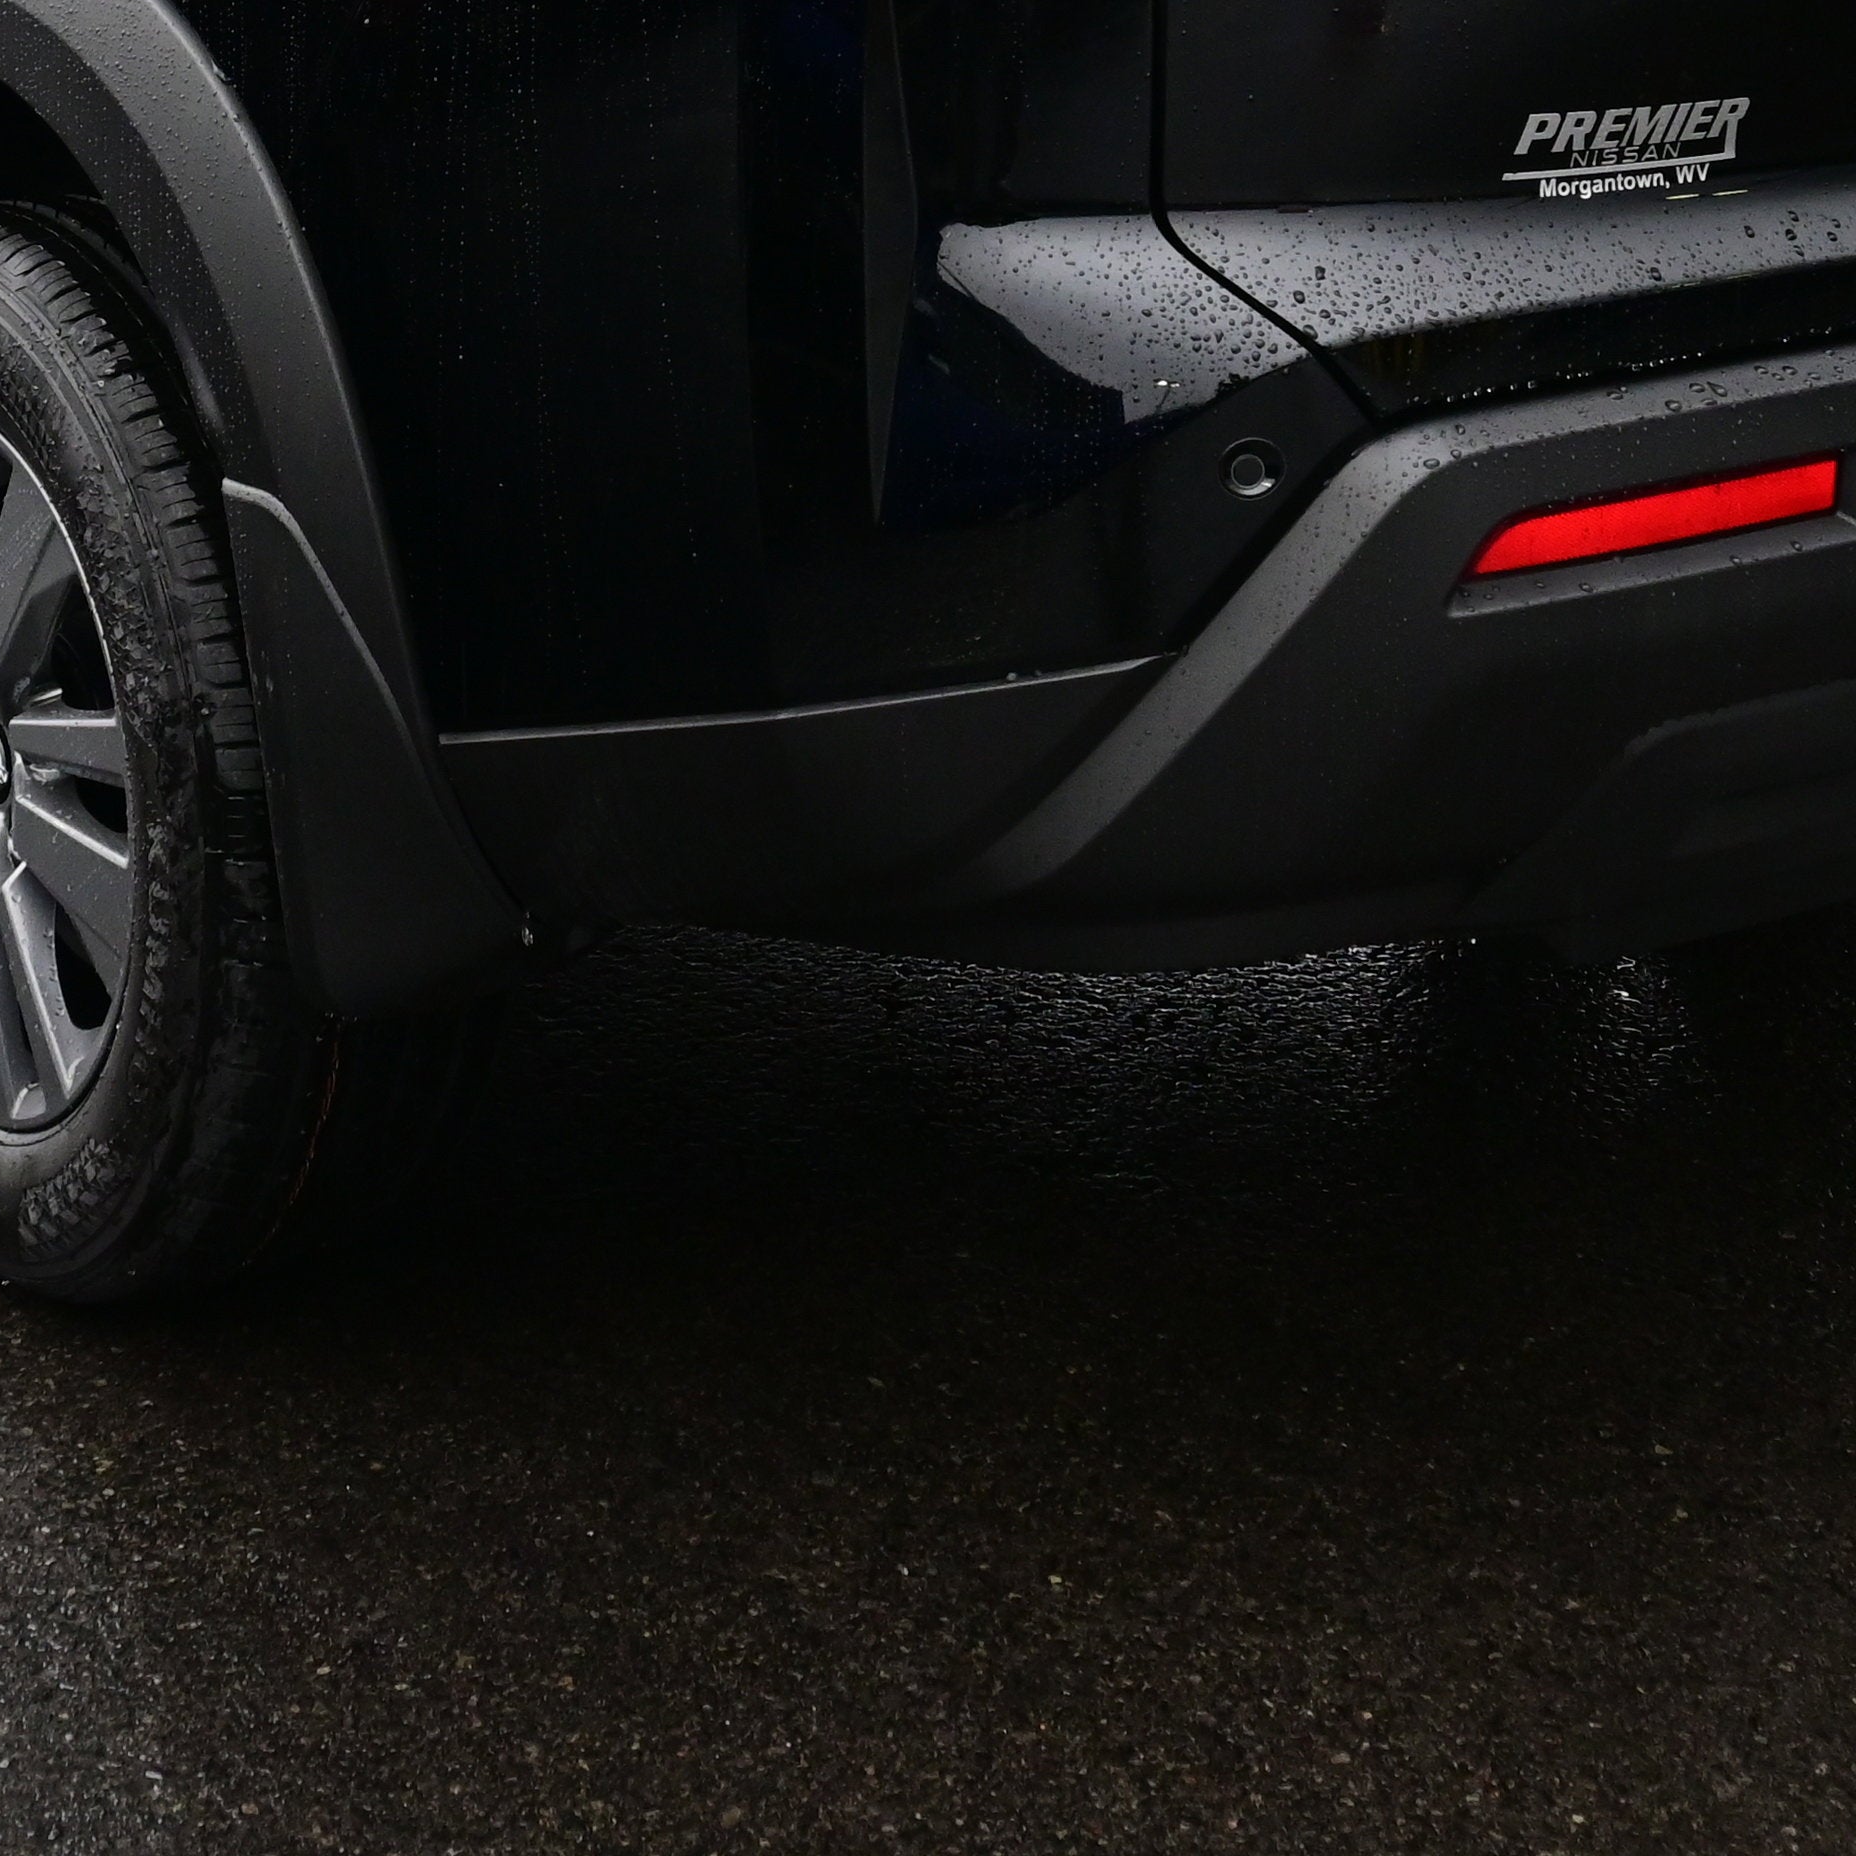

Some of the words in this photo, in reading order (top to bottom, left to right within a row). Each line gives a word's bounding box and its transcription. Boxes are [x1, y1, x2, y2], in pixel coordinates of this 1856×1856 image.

[1513, 97, 1750, 158] PREMIER
[1569, 142, 1681, 169] NISSAN
[1539, 176, 1670, 200] Morgantown,
[1675, 163, 1710, 185] WV
